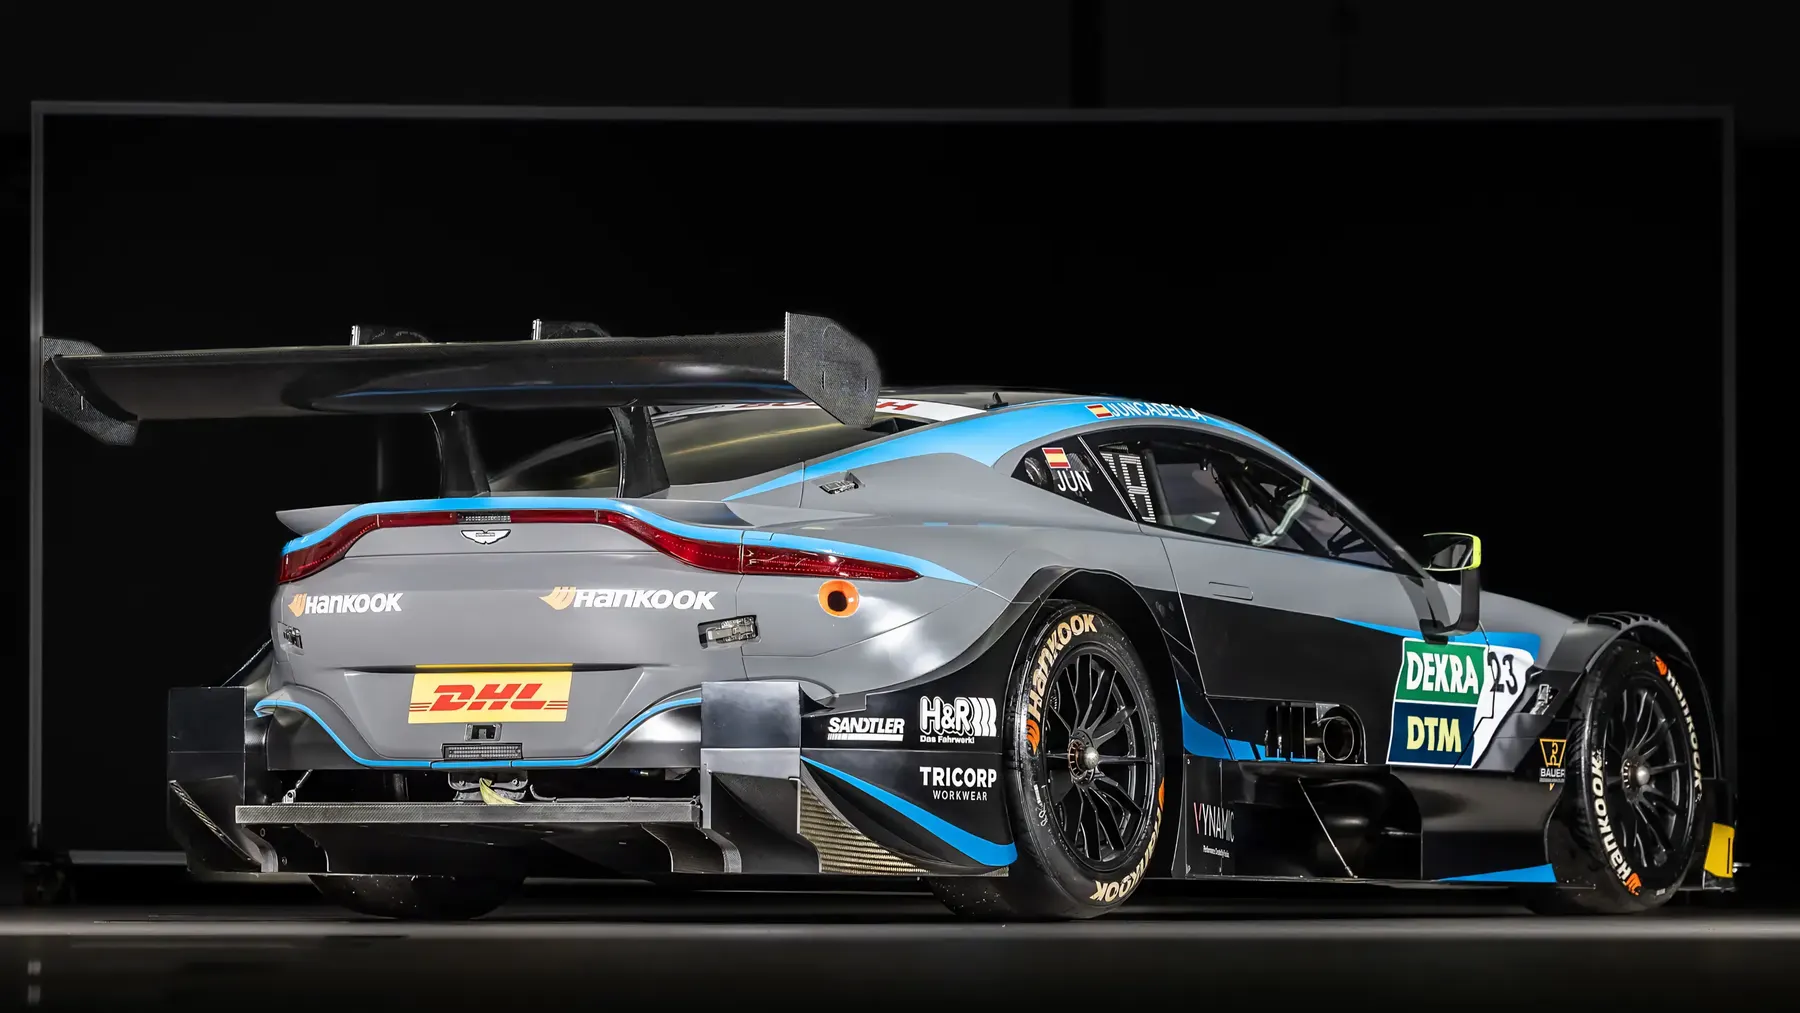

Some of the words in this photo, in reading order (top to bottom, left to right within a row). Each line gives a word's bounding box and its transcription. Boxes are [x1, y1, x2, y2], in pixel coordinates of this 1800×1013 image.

[1107, 402, 1207, 421] JUNCADELLA
[1057, 470, 1093, 492] JUN
[1406, 651, 1479, 695] DEKRA
[1487, 651, 1518, 695] 23
[429, 683, 548, 711] DHL
[828, 717, 905, 734] SANDTLER
[920, 696, 974, 736] H&R
[920, 735, 937, 743] Das
[1407, 715, 1462, 753] DTM
[919, 766, 997, 788] TRICORP
[1540, 768, 1566, 778] BAUER
[933, 789, 988, 801] WORKWEAR
